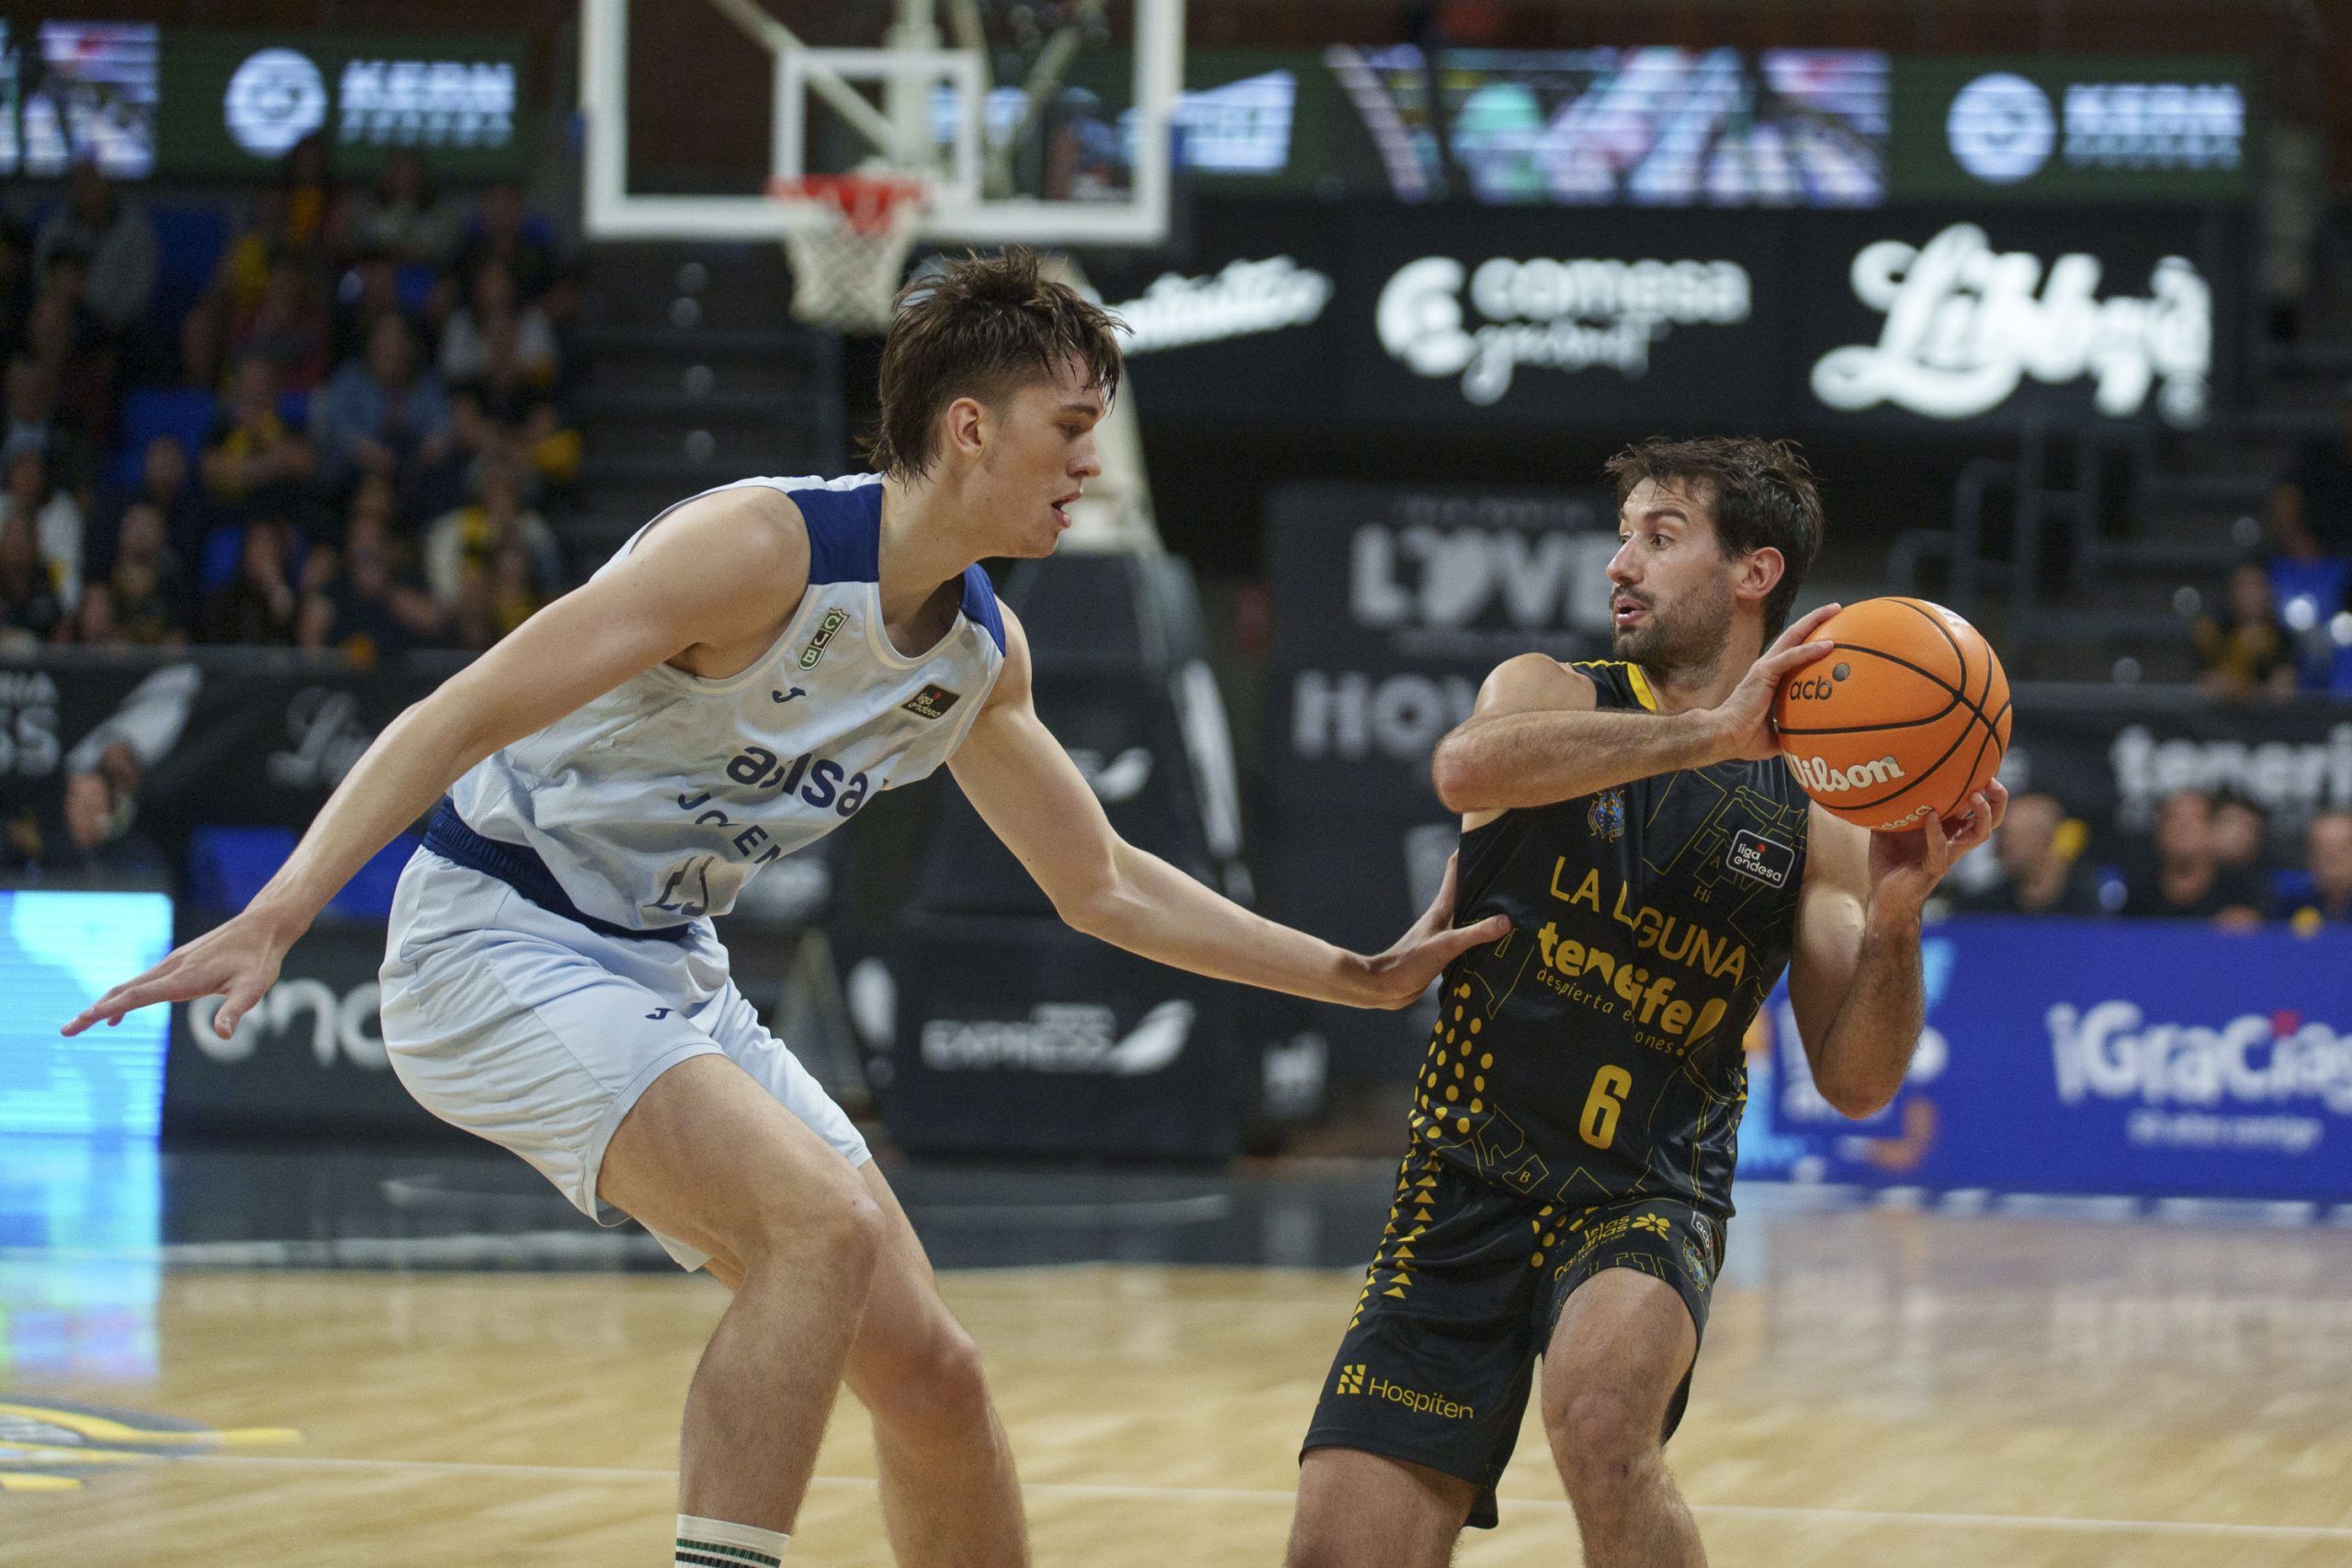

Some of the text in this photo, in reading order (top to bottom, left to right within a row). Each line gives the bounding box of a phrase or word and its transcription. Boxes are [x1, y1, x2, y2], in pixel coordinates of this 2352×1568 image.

[1473, 257, 1751, 323] comesa
[1789, 676, 1832, 701] acb
[1734, 855, 1782, 882] endesa
[1737, 842, 1761, 860] liga
[1550, 855, 1600, 912] LA
[1612, 880, 1746, 987] LGUNA
[1536, 968, 1614, 1014] despierta
[1579, 1064, 1633, 1149] 6
[1368, 1377, 1474, 1419] Hospiten
